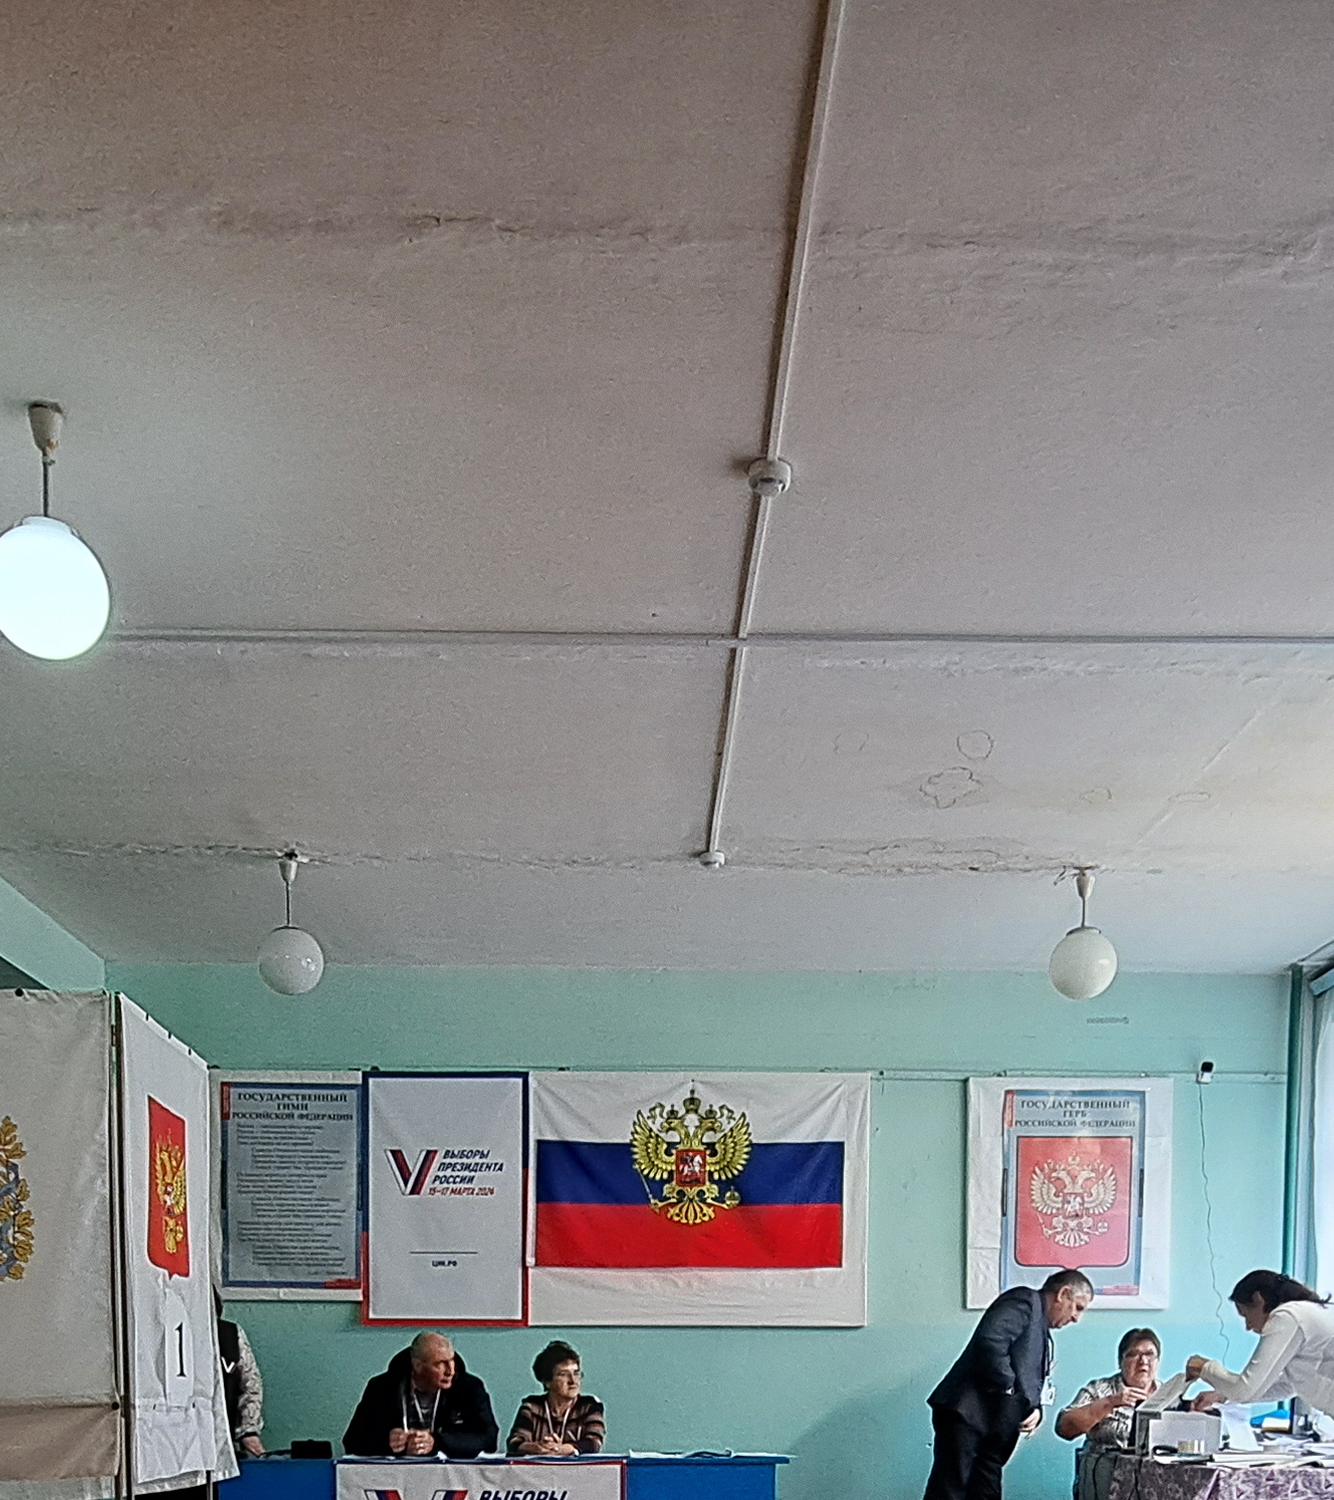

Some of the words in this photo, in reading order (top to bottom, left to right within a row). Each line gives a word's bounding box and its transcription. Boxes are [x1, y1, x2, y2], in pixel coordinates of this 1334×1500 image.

[237, 1092, 348, 1103] ГОСУДАРСТВЕННЫЙ
[276, 1102, 309, 1111] ГИМН
[1021, 1100, 1130, 1110] ГОСУДАРСТВЕННЫЙ
[232, 1111, 295, 1120] РОССИЙСКОЙ
[297, 1112, 354, 1121] ФЕДЕРАЦИИ
[1063, 1110, 1088, 1118] ГЕРБ
[1015, 1119, 1077, 1127] РОССИЙСКОЙ
[1080, 1119, 1136, 1128] ФЕДЕРАЦИИ
[443, 1149, 491, 1160] ВЫБОРЫ
[437, 1162, 504, 1173] ПРЕЗИДЕНТА
[432, 1175, 475, 1185] РОССИИ
[449, 1187, 475, 1196] МАРТА
[476, 1187, 495, 1196] 2024
[175, 1321, 187, 1378] 1
